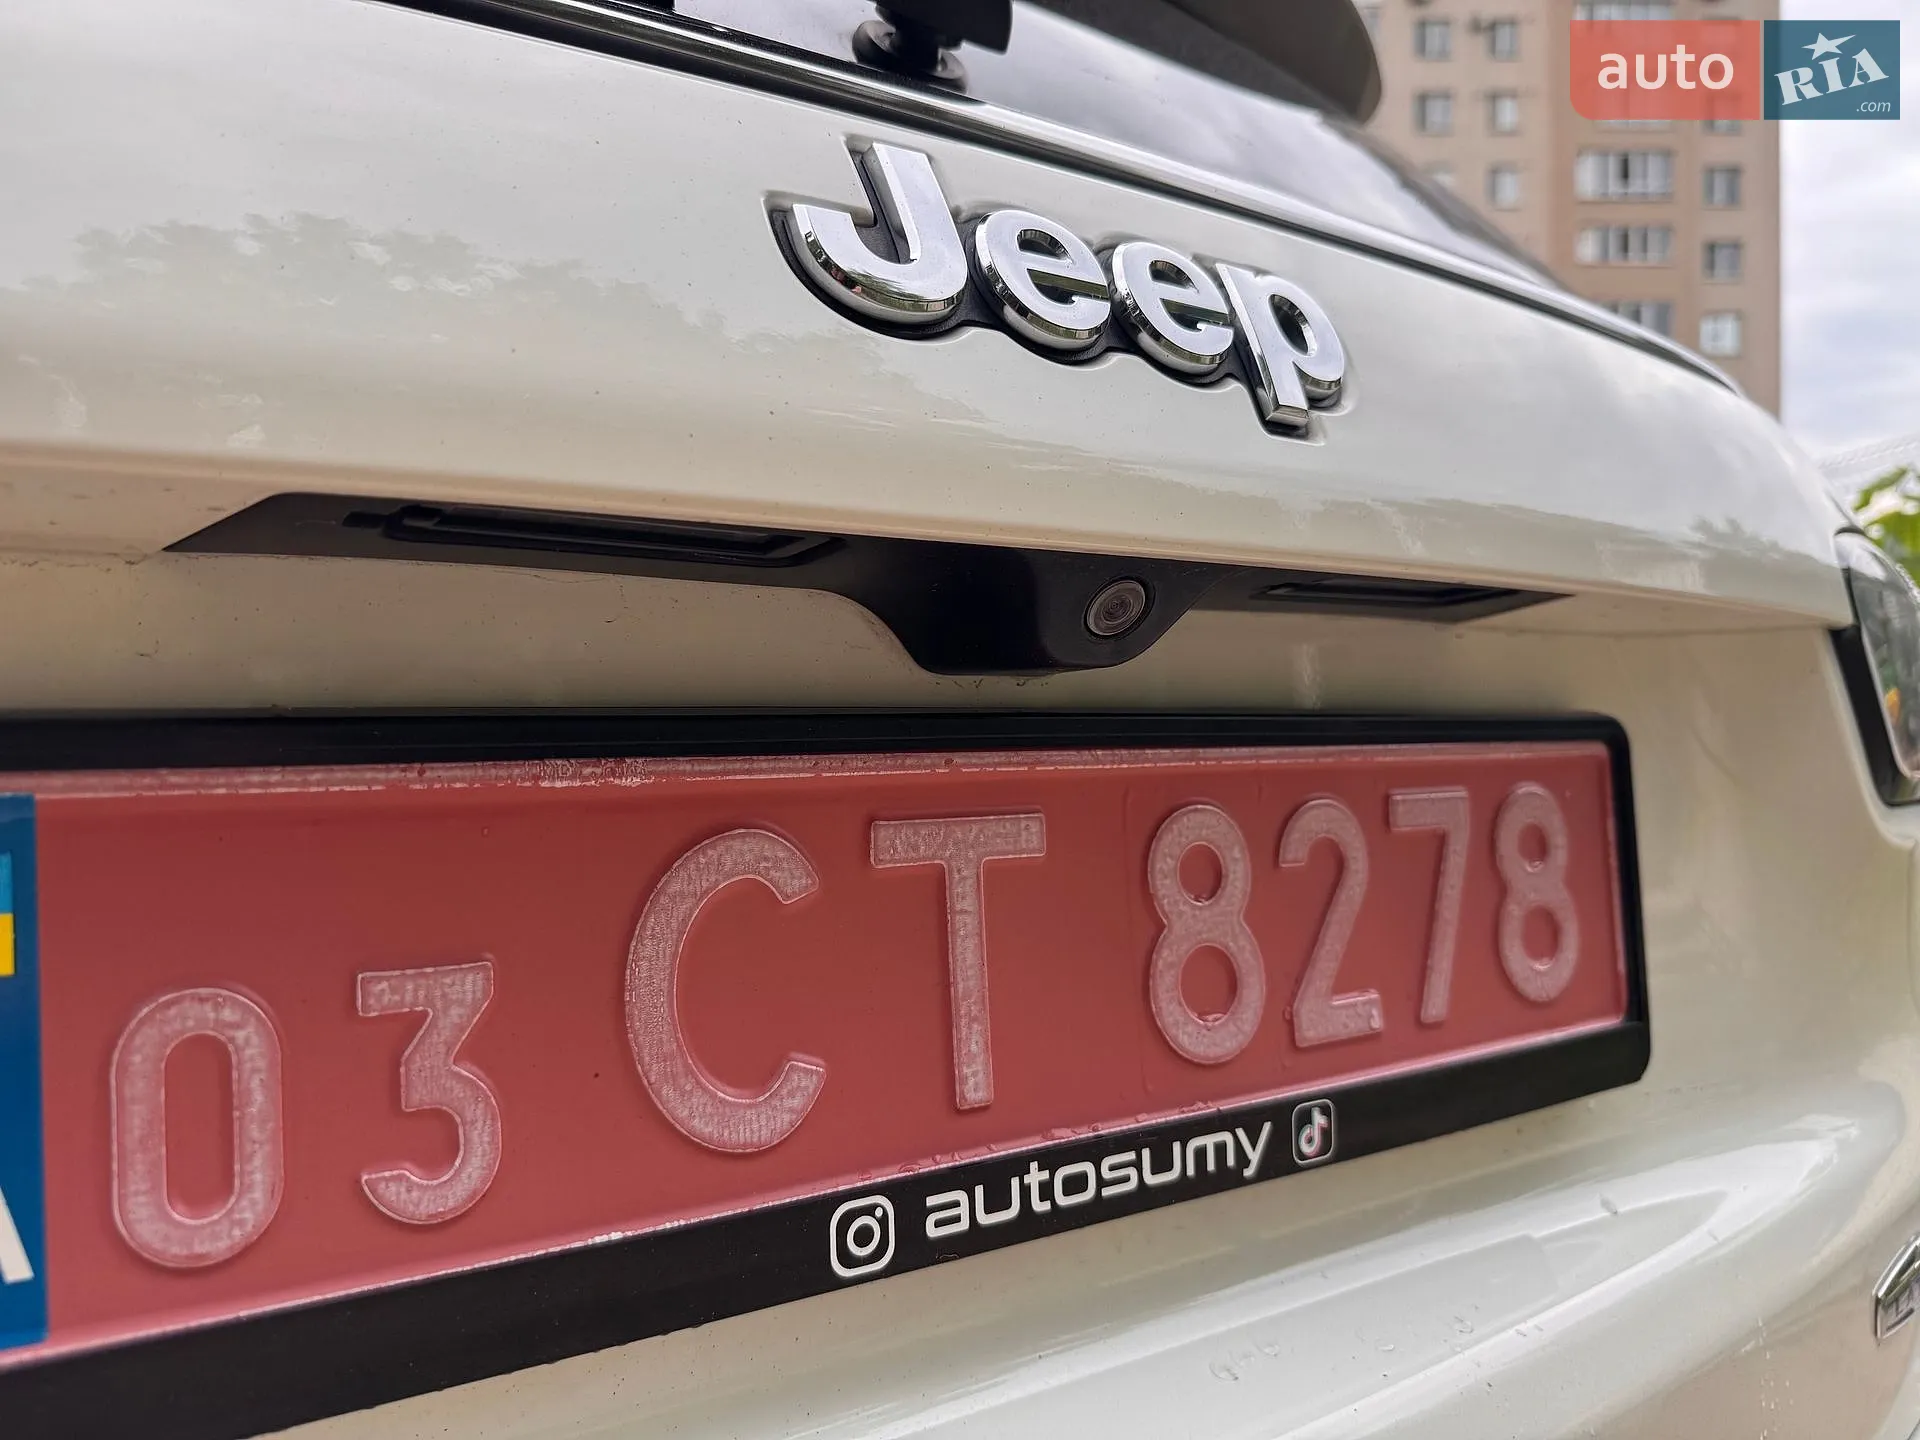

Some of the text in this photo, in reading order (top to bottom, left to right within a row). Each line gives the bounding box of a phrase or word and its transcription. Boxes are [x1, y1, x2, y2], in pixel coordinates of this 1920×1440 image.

[791, 141, 1347, 425] Jeep
[110, 782, 1581, 1269] 03 CT 8278
[925, 1121, 1272, 1238] autosumy
